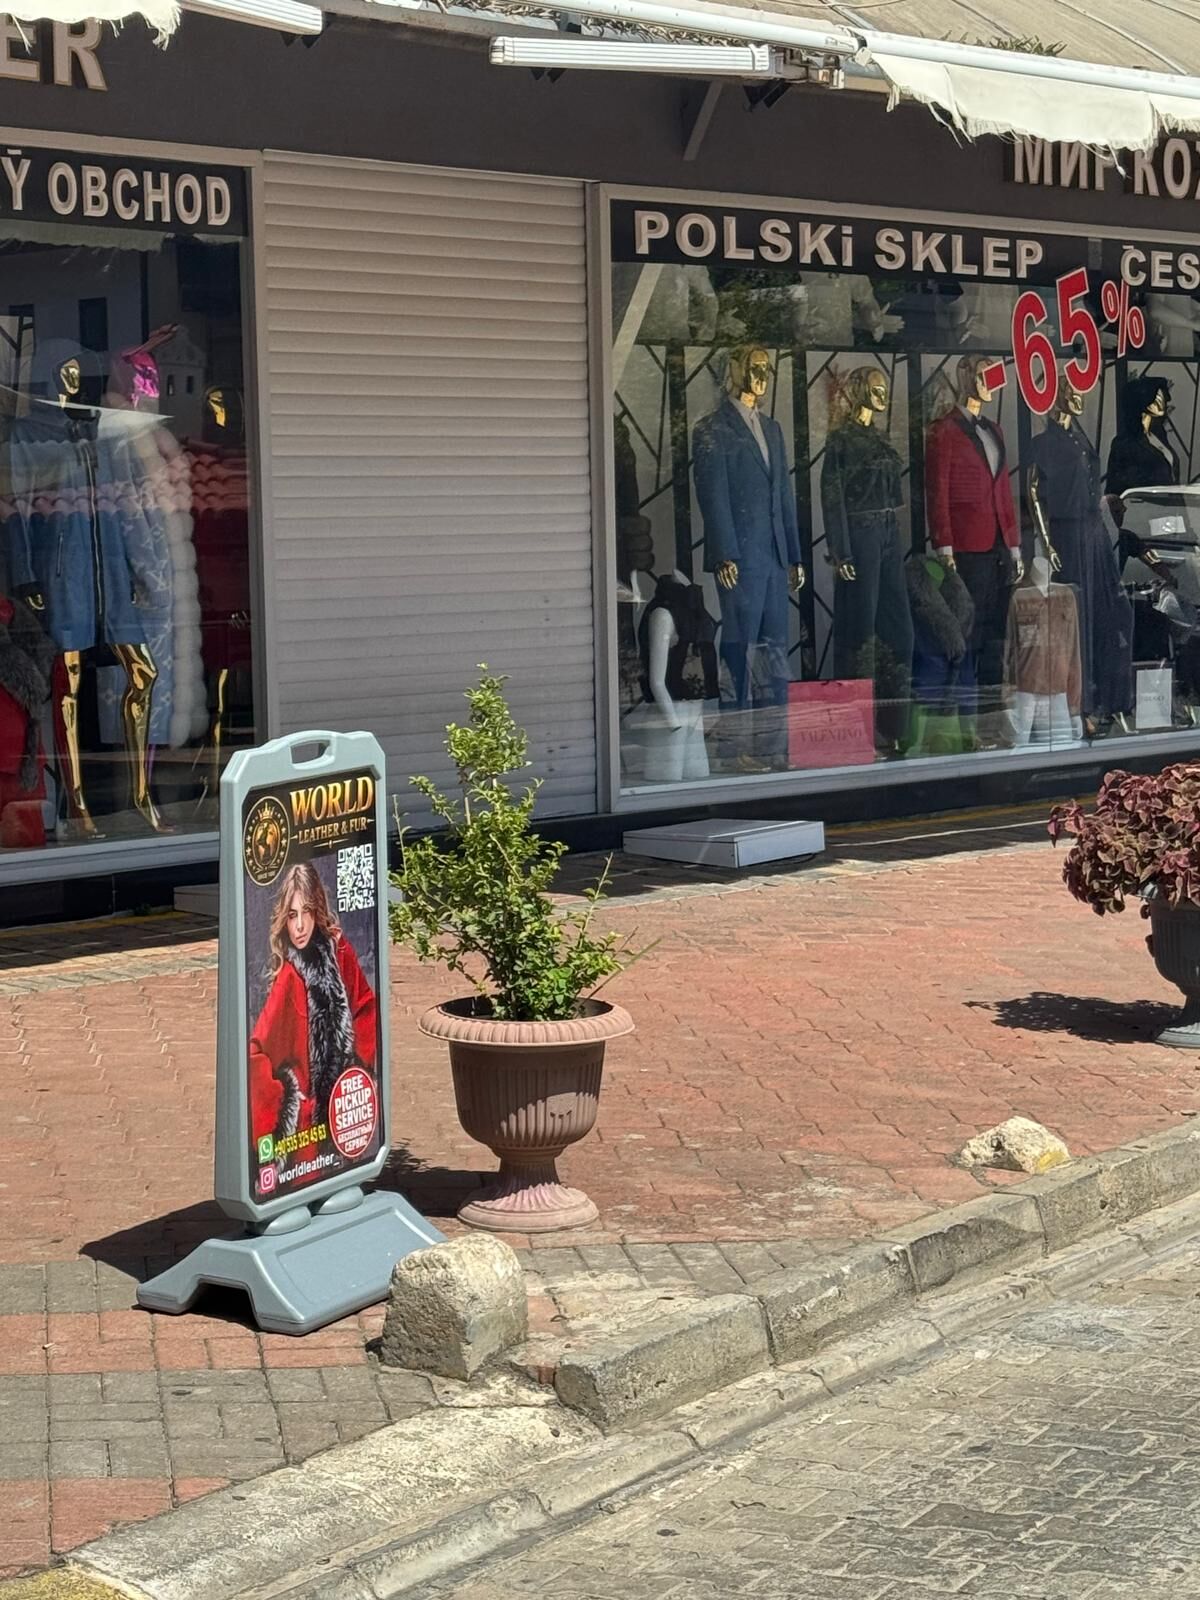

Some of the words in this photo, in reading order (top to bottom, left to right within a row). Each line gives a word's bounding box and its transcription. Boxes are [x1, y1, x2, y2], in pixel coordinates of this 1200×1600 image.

[48, 162, 231, 226] OBCHOD
[874, 227, 1043, 279] SKLEP
[289, 776, 374, 826] WORLD
[298, 822, 340, 844] LEATHER
[350, 816, 368, 833] FUR
[340, 1073, 364, 1096] FREE
[334, 1087, 372, 1115] PICKUP
[335, 1102, 374, 1131] SERVICE
